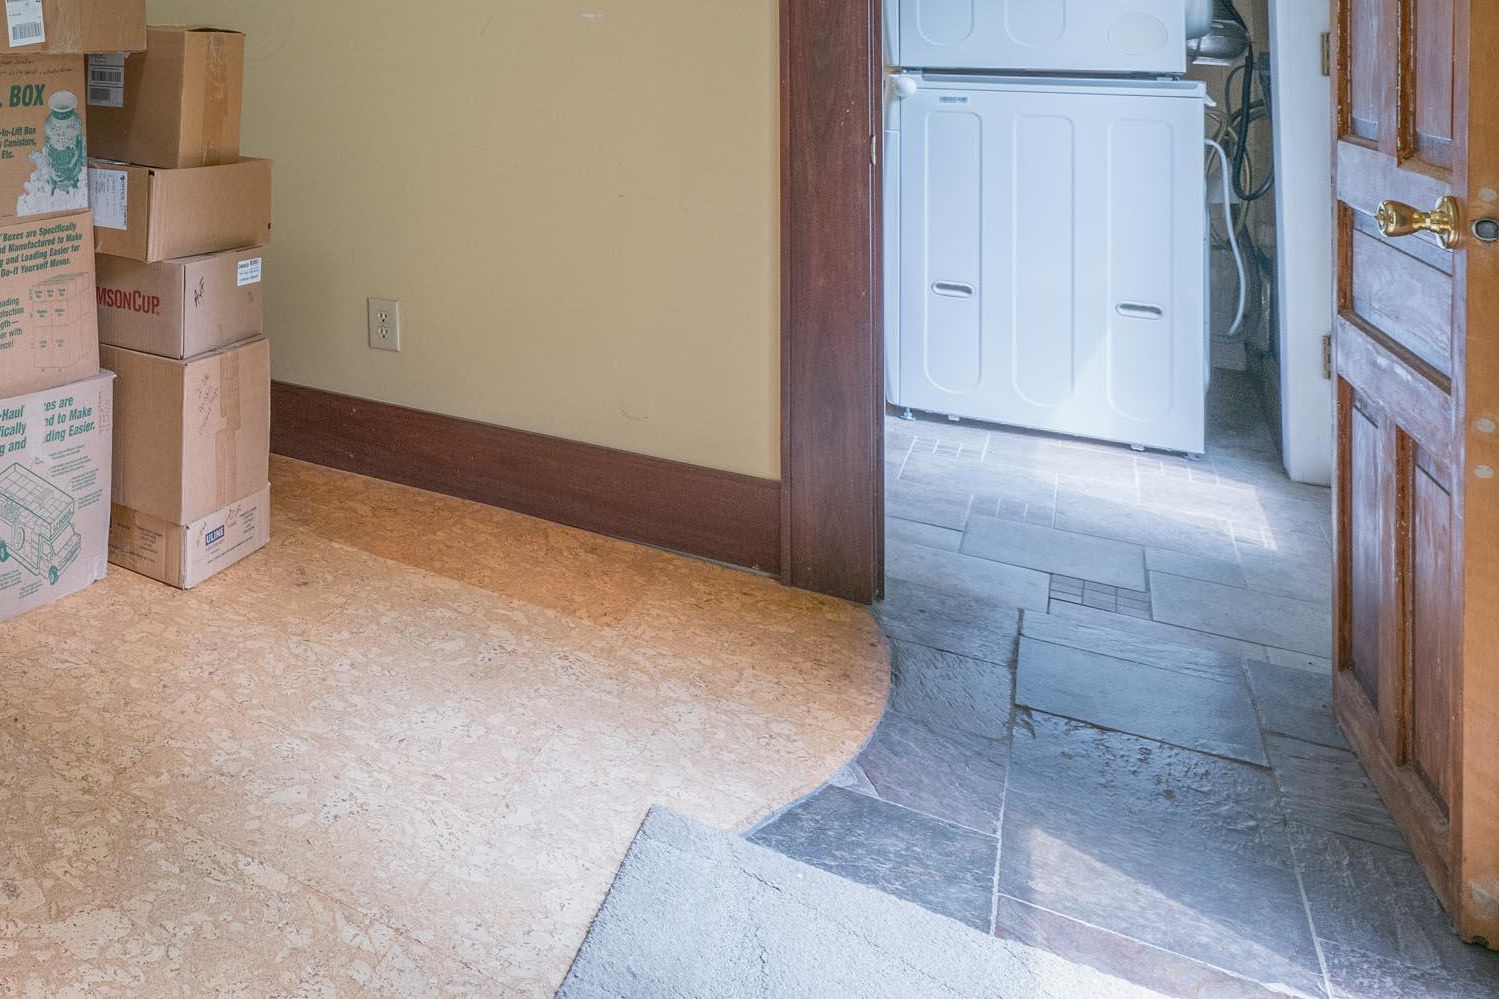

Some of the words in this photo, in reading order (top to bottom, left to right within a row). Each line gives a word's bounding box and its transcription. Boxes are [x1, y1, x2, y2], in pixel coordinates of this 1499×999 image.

[10, 84, 46, 107] BOX
[24, 127, 36, 135] Box
[4, 138, 37, 148] Canisters,
[2, 150, 14, 159] Etc.
[3, 232, 23, 242] Boxes
[26, 230, 36, 238] are
[39, 222, 76, 237] Specifically
[8, 237, 55, 252] Manufactured
[58, 235, 64, 243] to
[66, 233, 82, 242] Make
[6, 255, 19, 265] and
[21, 250, 47, 262] Loading
[50, 245, 69, 256] Easier
[71, 244, 80, 252] for
[21, 260, 48, 274] Yourself
[96, 286, 160, 314] MSONCUP
[9, 327, 22, 336] with
[59, 396, 74, 408] are
[58, 413, 66, 424] to
[69, 407, 92, 421] Make
[68, 422, 95, 436] Easier.
[8, 437, 27, 452] and
[206, 526, 224, 544] ULINE
